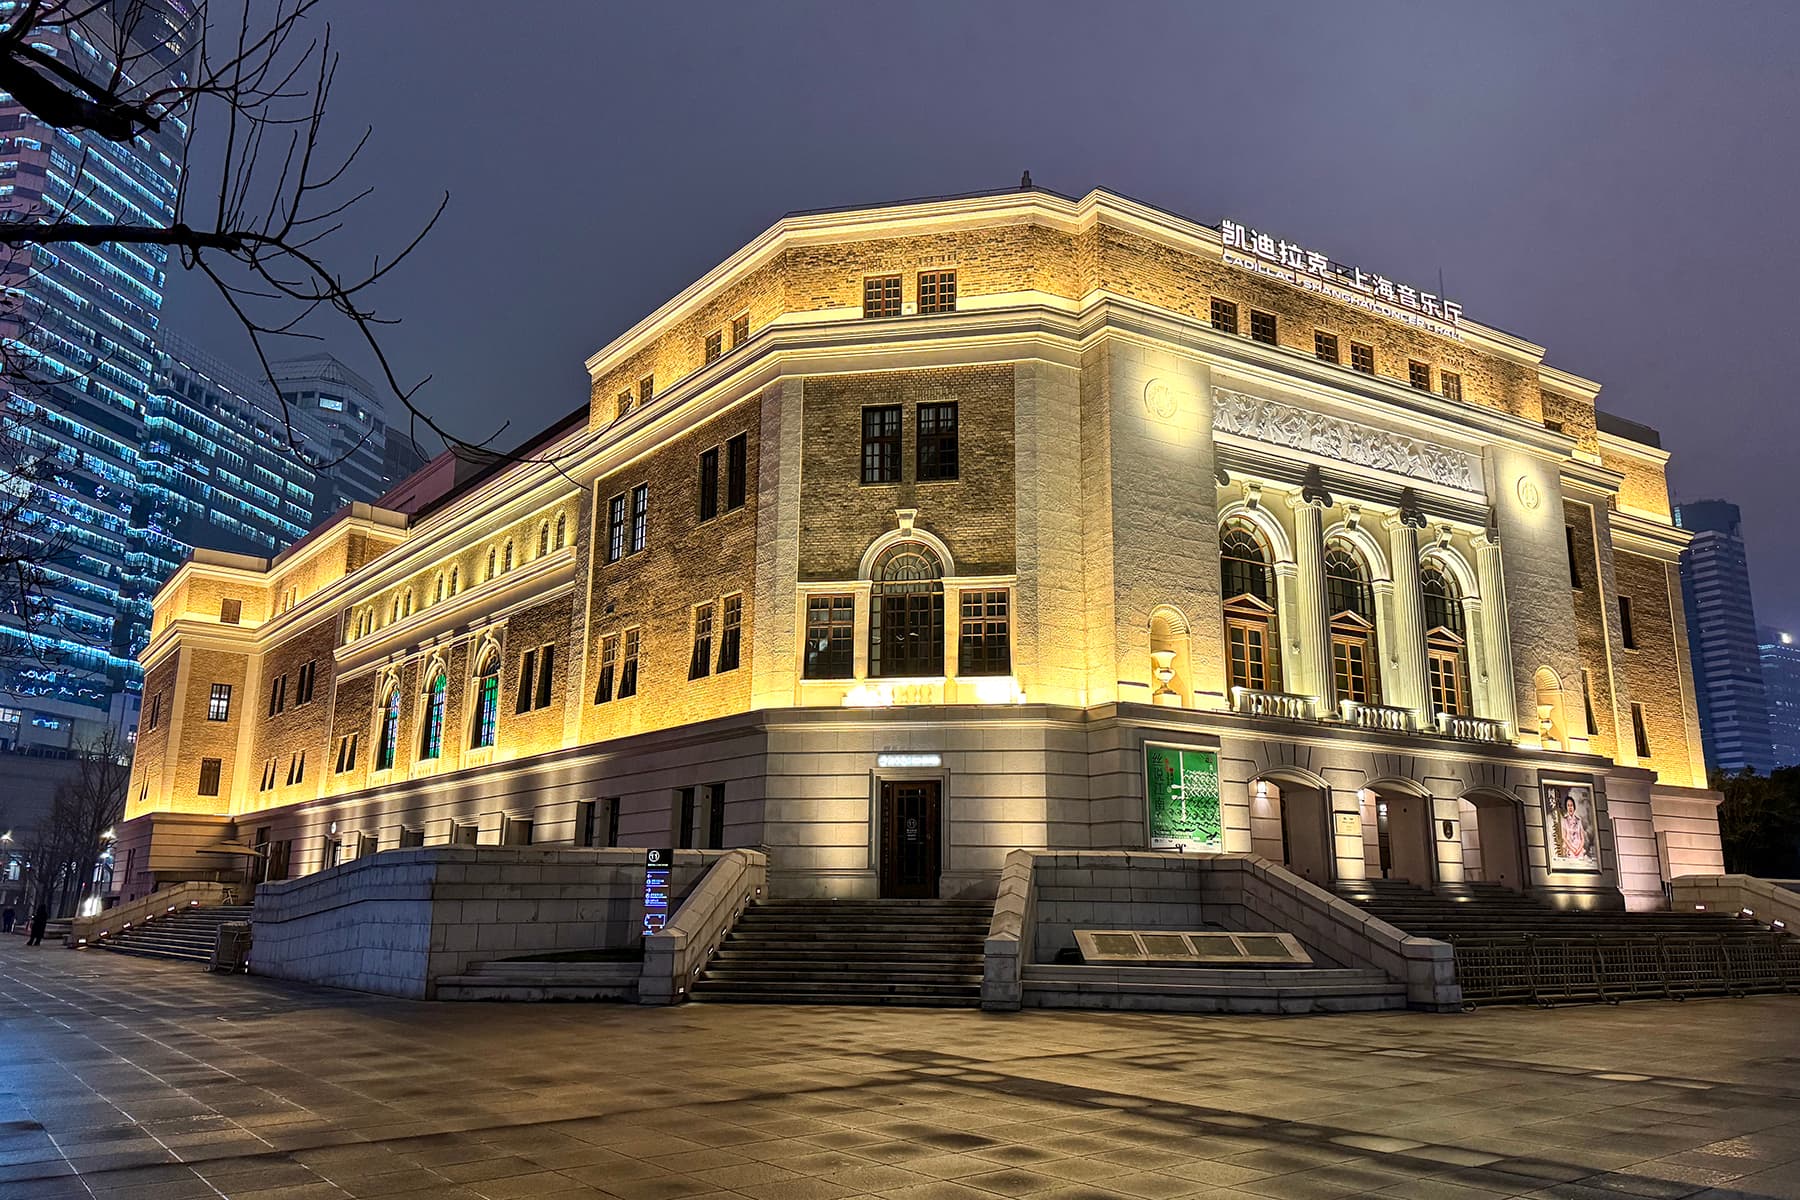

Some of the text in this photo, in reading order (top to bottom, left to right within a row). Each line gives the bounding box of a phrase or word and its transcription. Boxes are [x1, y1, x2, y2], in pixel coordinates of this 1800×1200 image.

[1222, 253, 1465, 343] CADILLAC SHANGHAI CONCERT HALL
